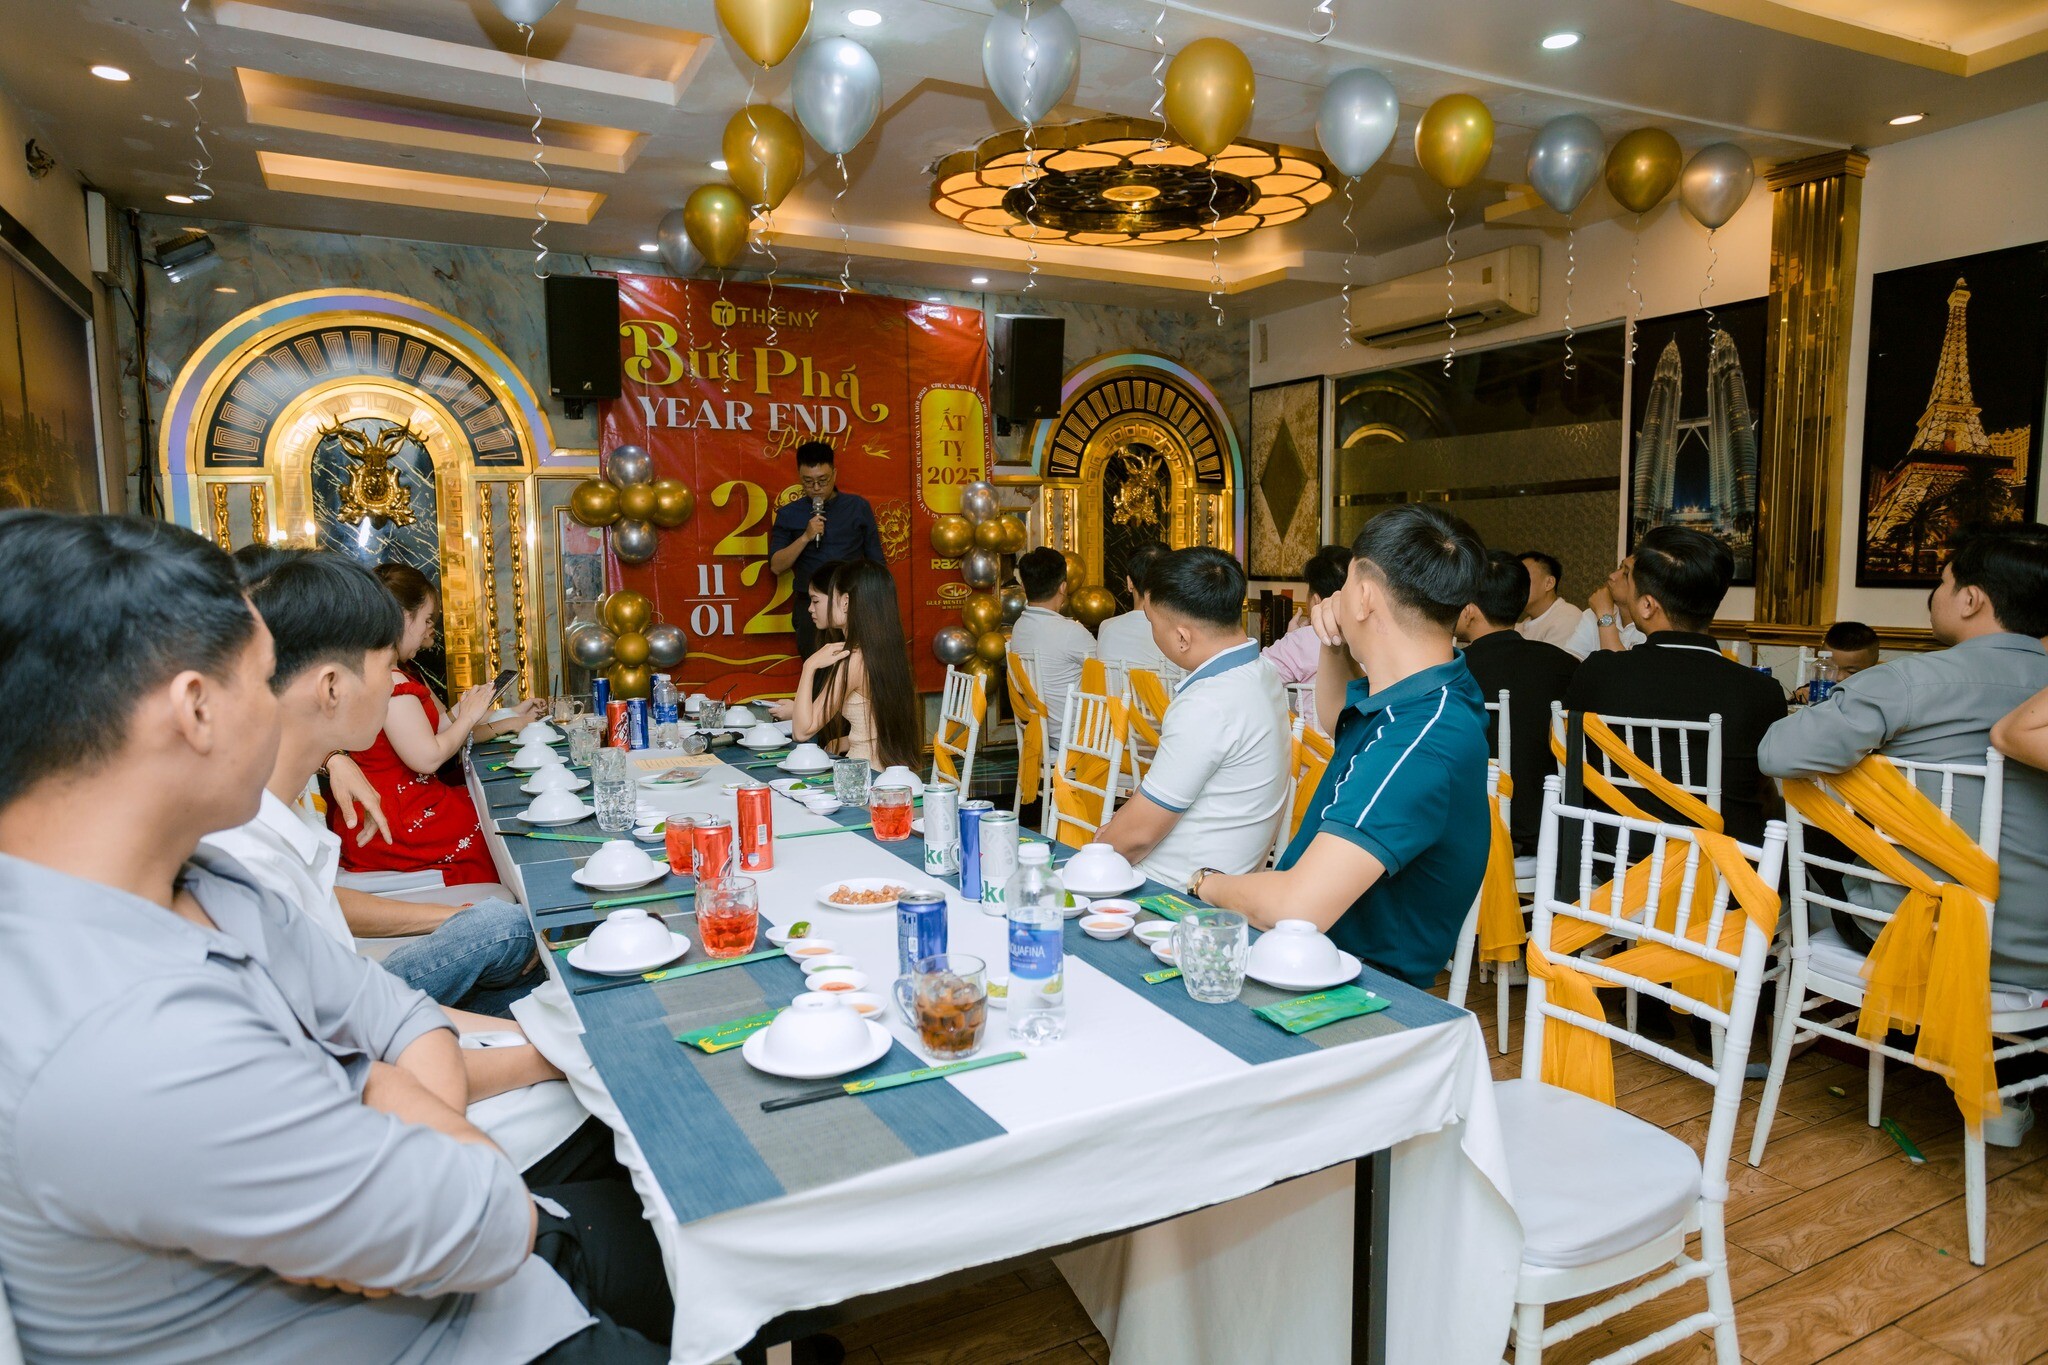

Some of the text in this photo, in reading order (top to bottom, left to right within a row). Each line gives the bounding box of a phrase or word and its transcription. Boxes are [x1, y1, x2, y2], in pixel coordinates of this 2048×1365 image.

[752, 347, 889, 423] Phá
[637, 396, 848, 434] YEAR END
[939, 407, 967, 431] ẤT
[939, 440, 966, 462] TỴ
[927, 466, 980, 485] 2025
